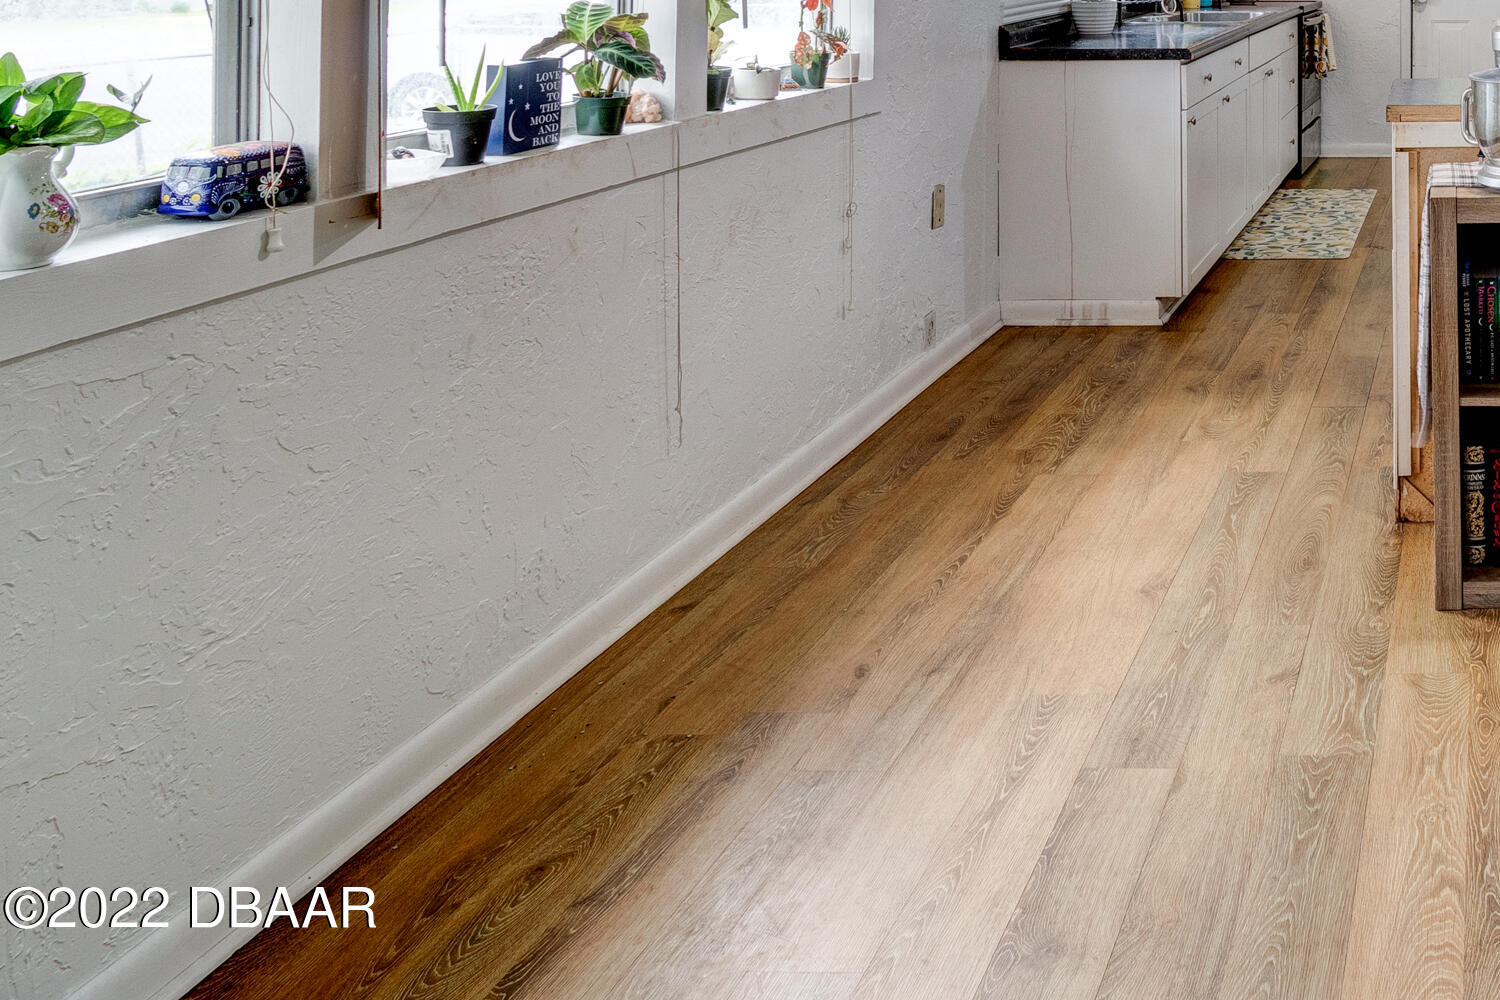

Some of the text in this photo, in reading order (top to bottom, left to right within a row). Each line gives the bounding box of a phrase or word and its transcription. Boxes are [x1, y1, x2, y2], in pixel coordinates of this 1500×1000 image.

[535, 70, 561, 82] LOVE
[539, 81, 560, 92] YOU
[546, 91, 560, 101] TO
[539, 102, 560, 113] THE
[530, 112, 559, 126] MOON
[538, 123, 559, 135] AND
[532, 132, 559, 147] BACK
[1487, 286, 1496, 323] CHOSEN
[1463, 298, 1472, 364] LOST APOTHECARY
